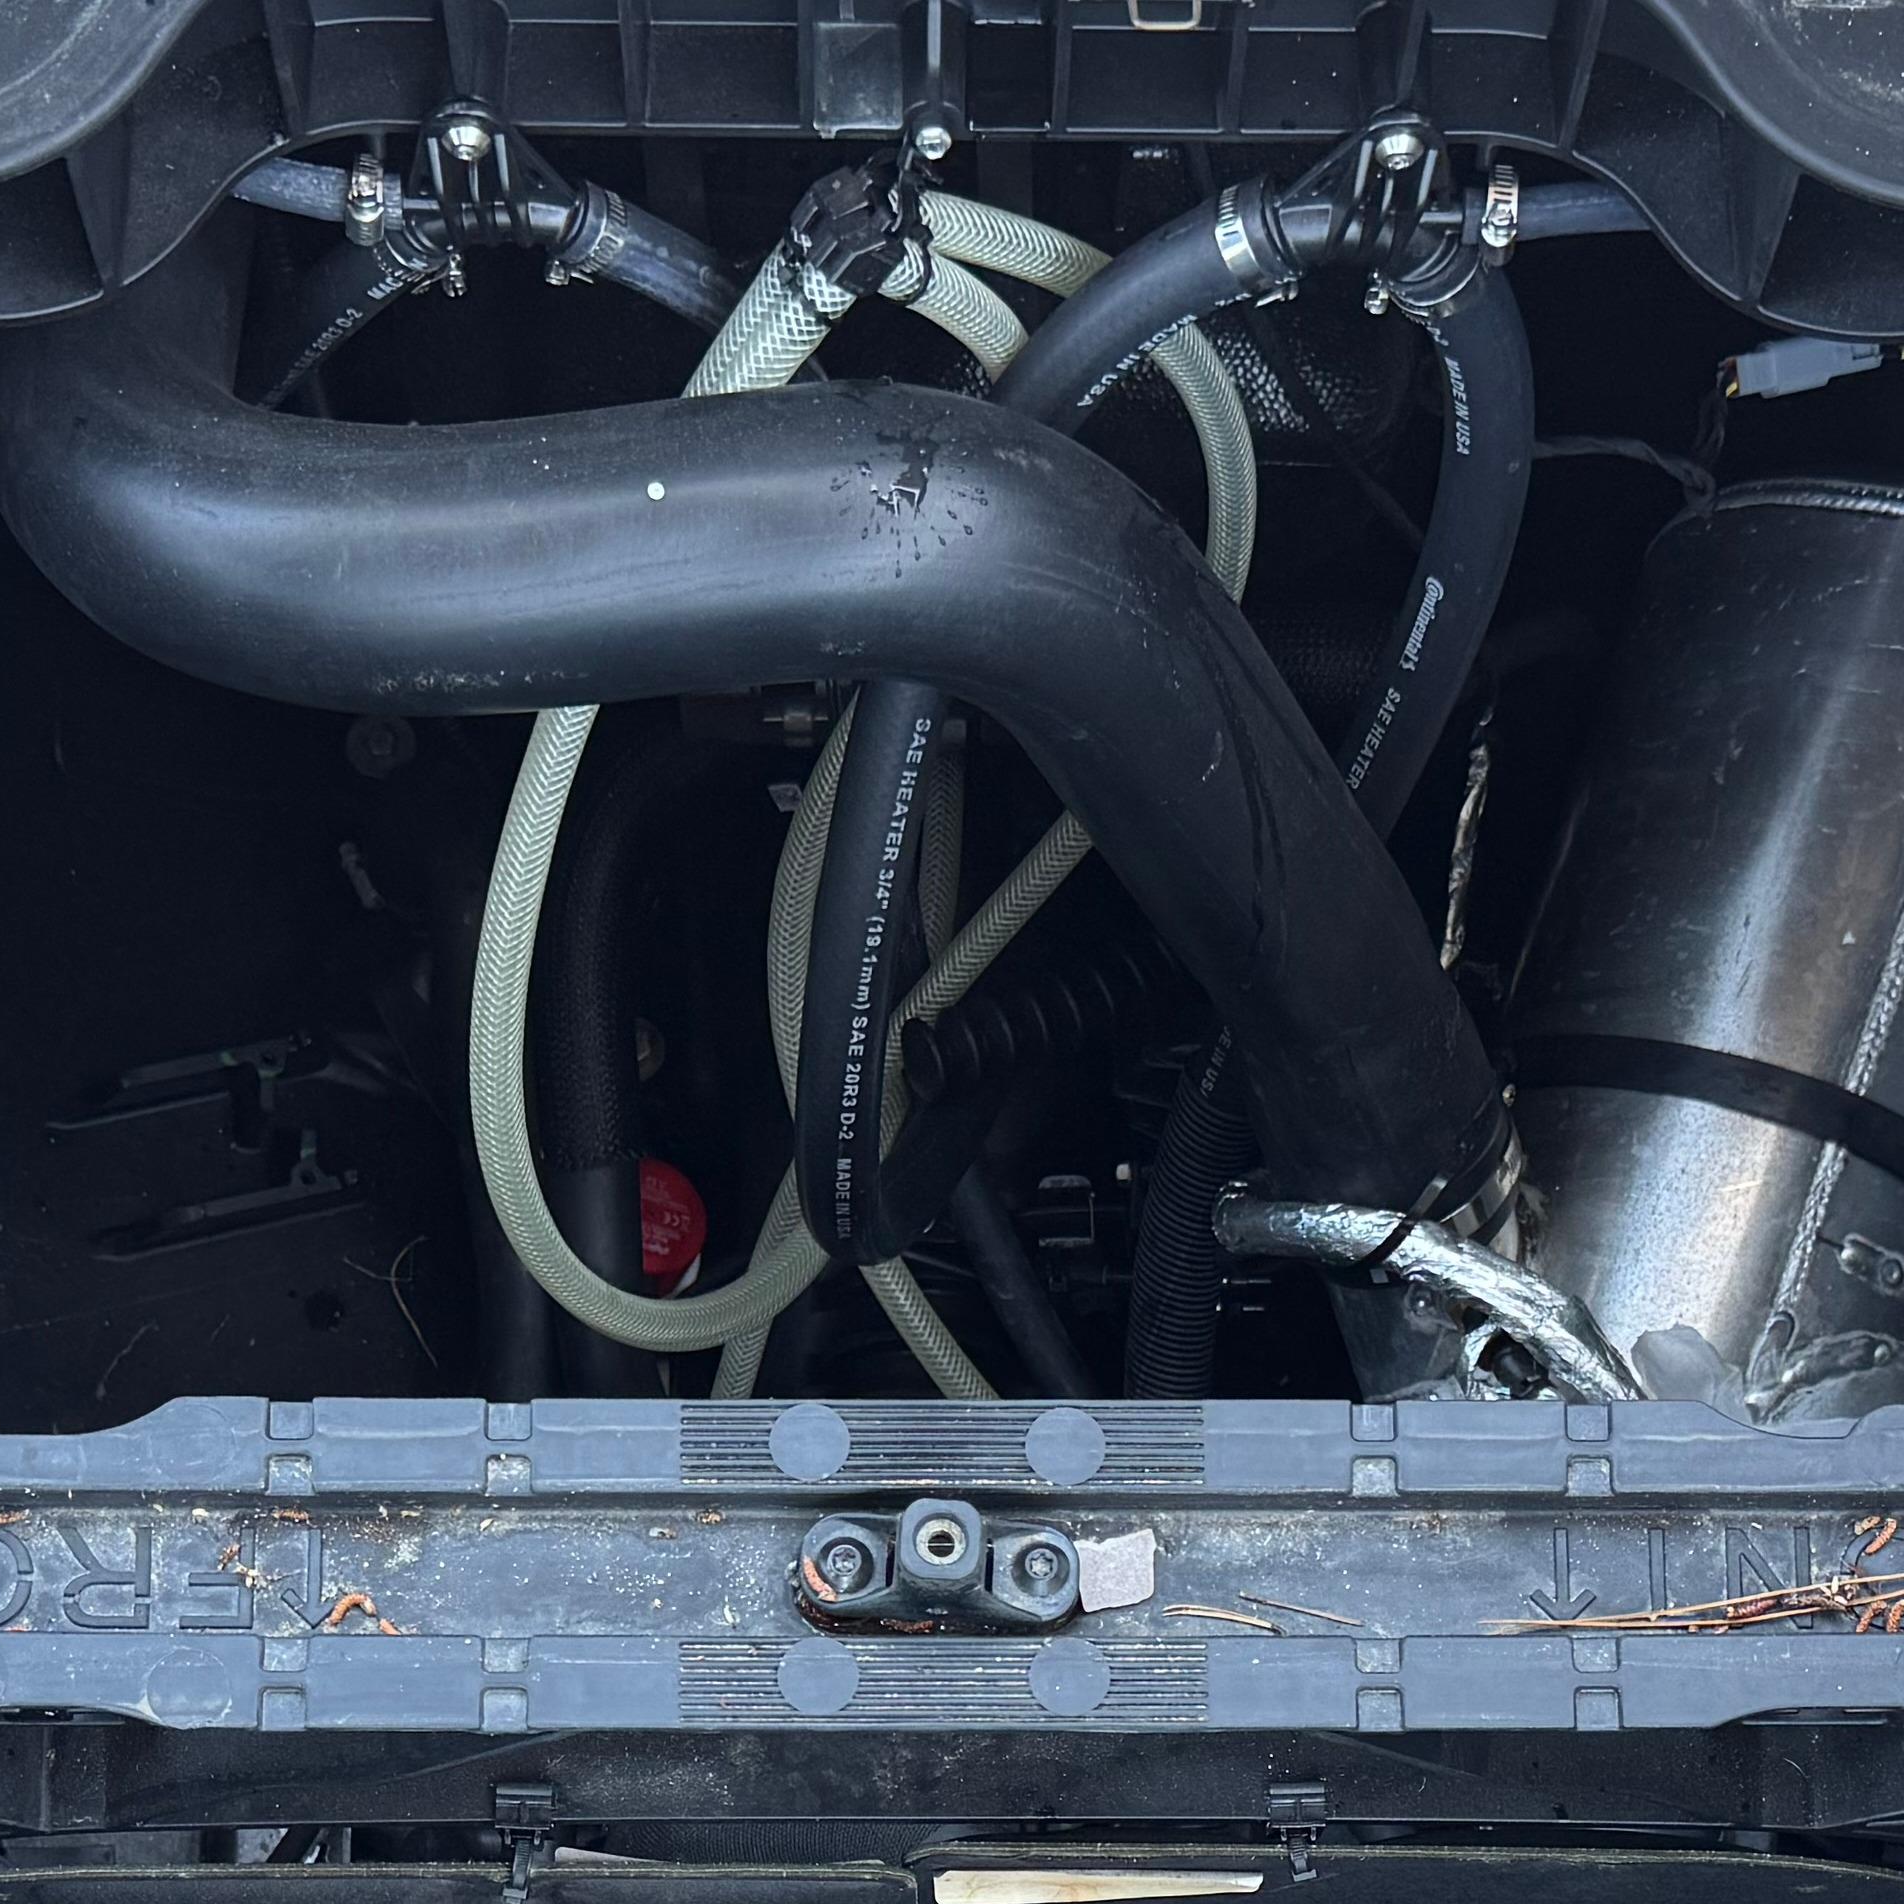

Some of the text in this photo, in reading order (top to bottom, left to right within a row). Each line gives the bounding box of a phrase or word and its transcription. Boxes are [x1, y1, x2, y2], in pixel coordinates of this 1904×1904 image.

[1076, 374, 1118, 407] USA
[1444, 356, 1471, 455] MADE IN USA
[1346, 576, 1444, 789] Continental SAE HEATER
[906, 718, 931, 764] SAE
[882, 771, 918, 862] HEATER
[848, 1016, 868, 1057] SAE
[842, 1063, 861, 1107] 20R3
[835, 1157, 852, 1200] MADE
